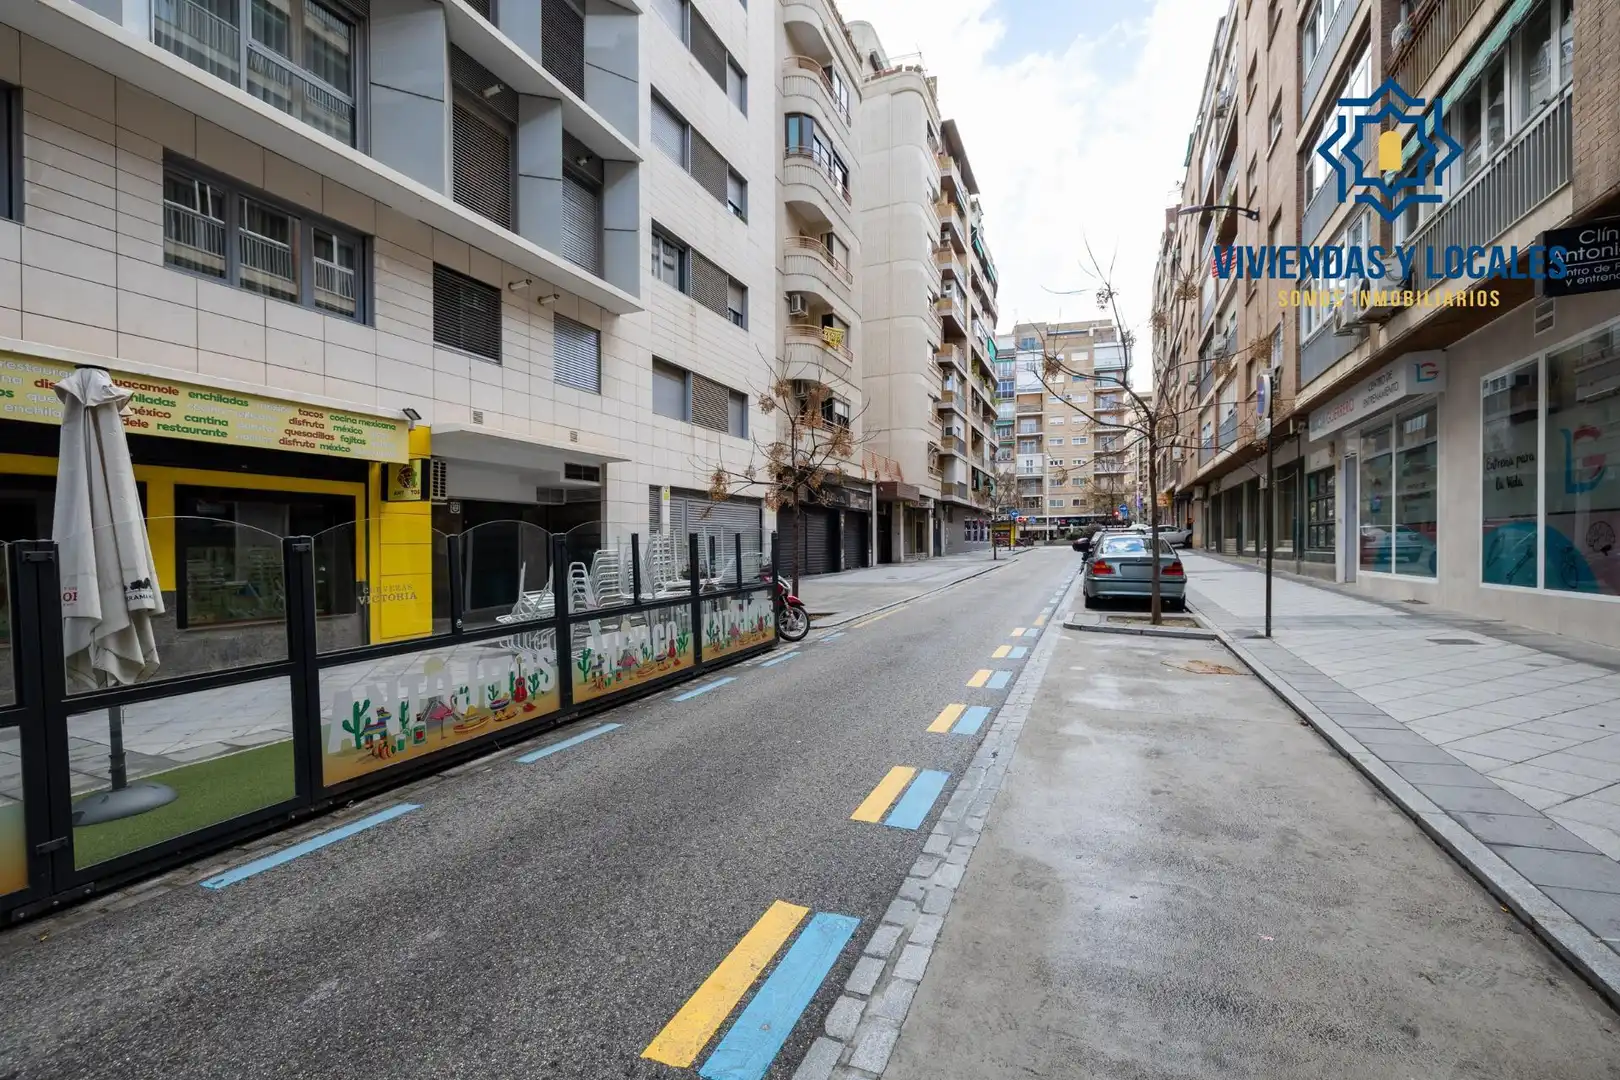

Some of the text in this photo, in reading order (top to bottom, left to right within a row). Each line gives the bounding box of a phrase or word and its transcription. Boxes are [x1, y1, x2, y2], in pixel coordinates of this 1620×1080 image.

[1550, 242, 1620, 264] Antoni
[1594, 265, 1610, 273] de
[1565, 279, 1573, 287] y
[188, 390, 249, 407] enchiladas
[298, 408, 324, 420] tacos
[329, 413, 358, 424] cocina
[358, 419, 397, 431] mexicana
[184, 414, 229, 427] cantina
[284, 428, 335, 441] quesadillas
[340, 434, 366, 446] fajitas
[289, 418, 325, 430] disfruta
[333, 425, 363, 435] méxico
[156, 421, 228, 438] restaurante
[279, 437, 316, 449] disfruta
[320, 442, 350, 453] méxico
[357, 591, 418, 605] VICTORIA
